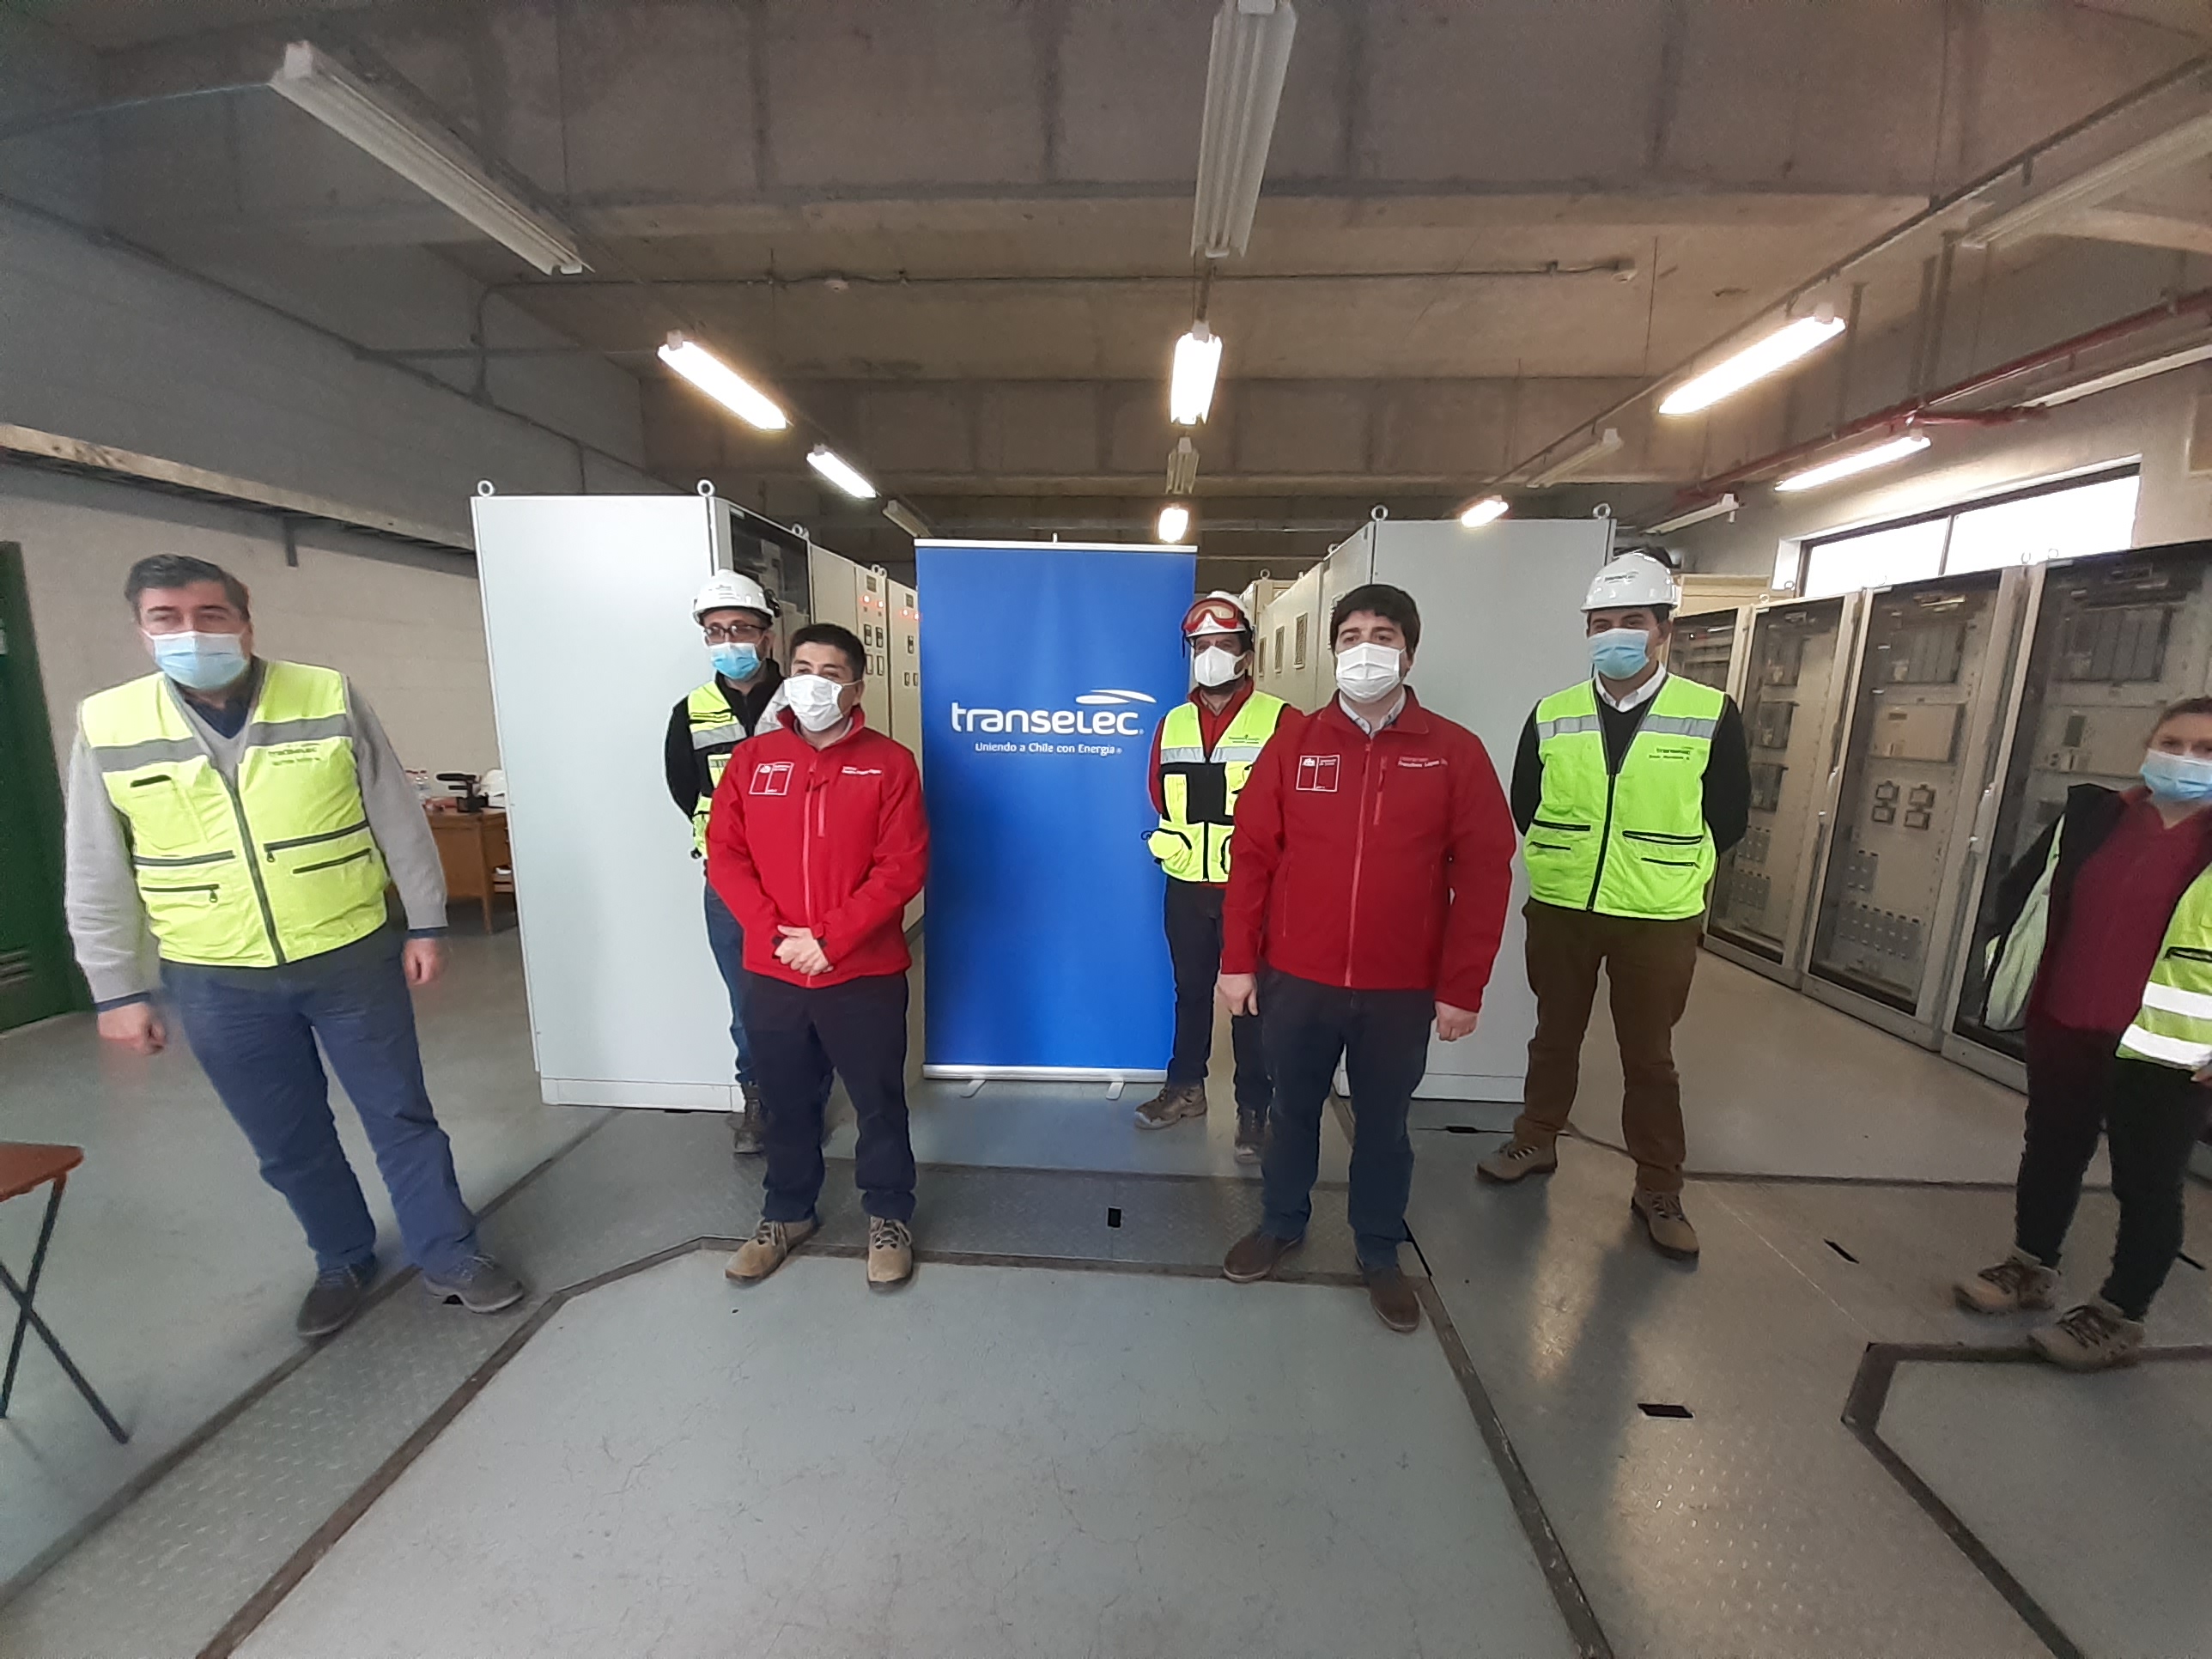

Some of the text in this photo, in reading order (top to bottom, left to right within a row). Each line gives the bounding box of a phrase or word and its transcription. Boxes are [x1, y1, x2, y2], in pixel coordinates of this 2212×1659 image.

[951, 702, 1139, 735] transelec
[975, 742, 1018, 752] Uniendo
[1019, 744, 1026, 752] a
[1029, 742, 1054, 753] Chile
[1056, 744, 1075, 753] con
